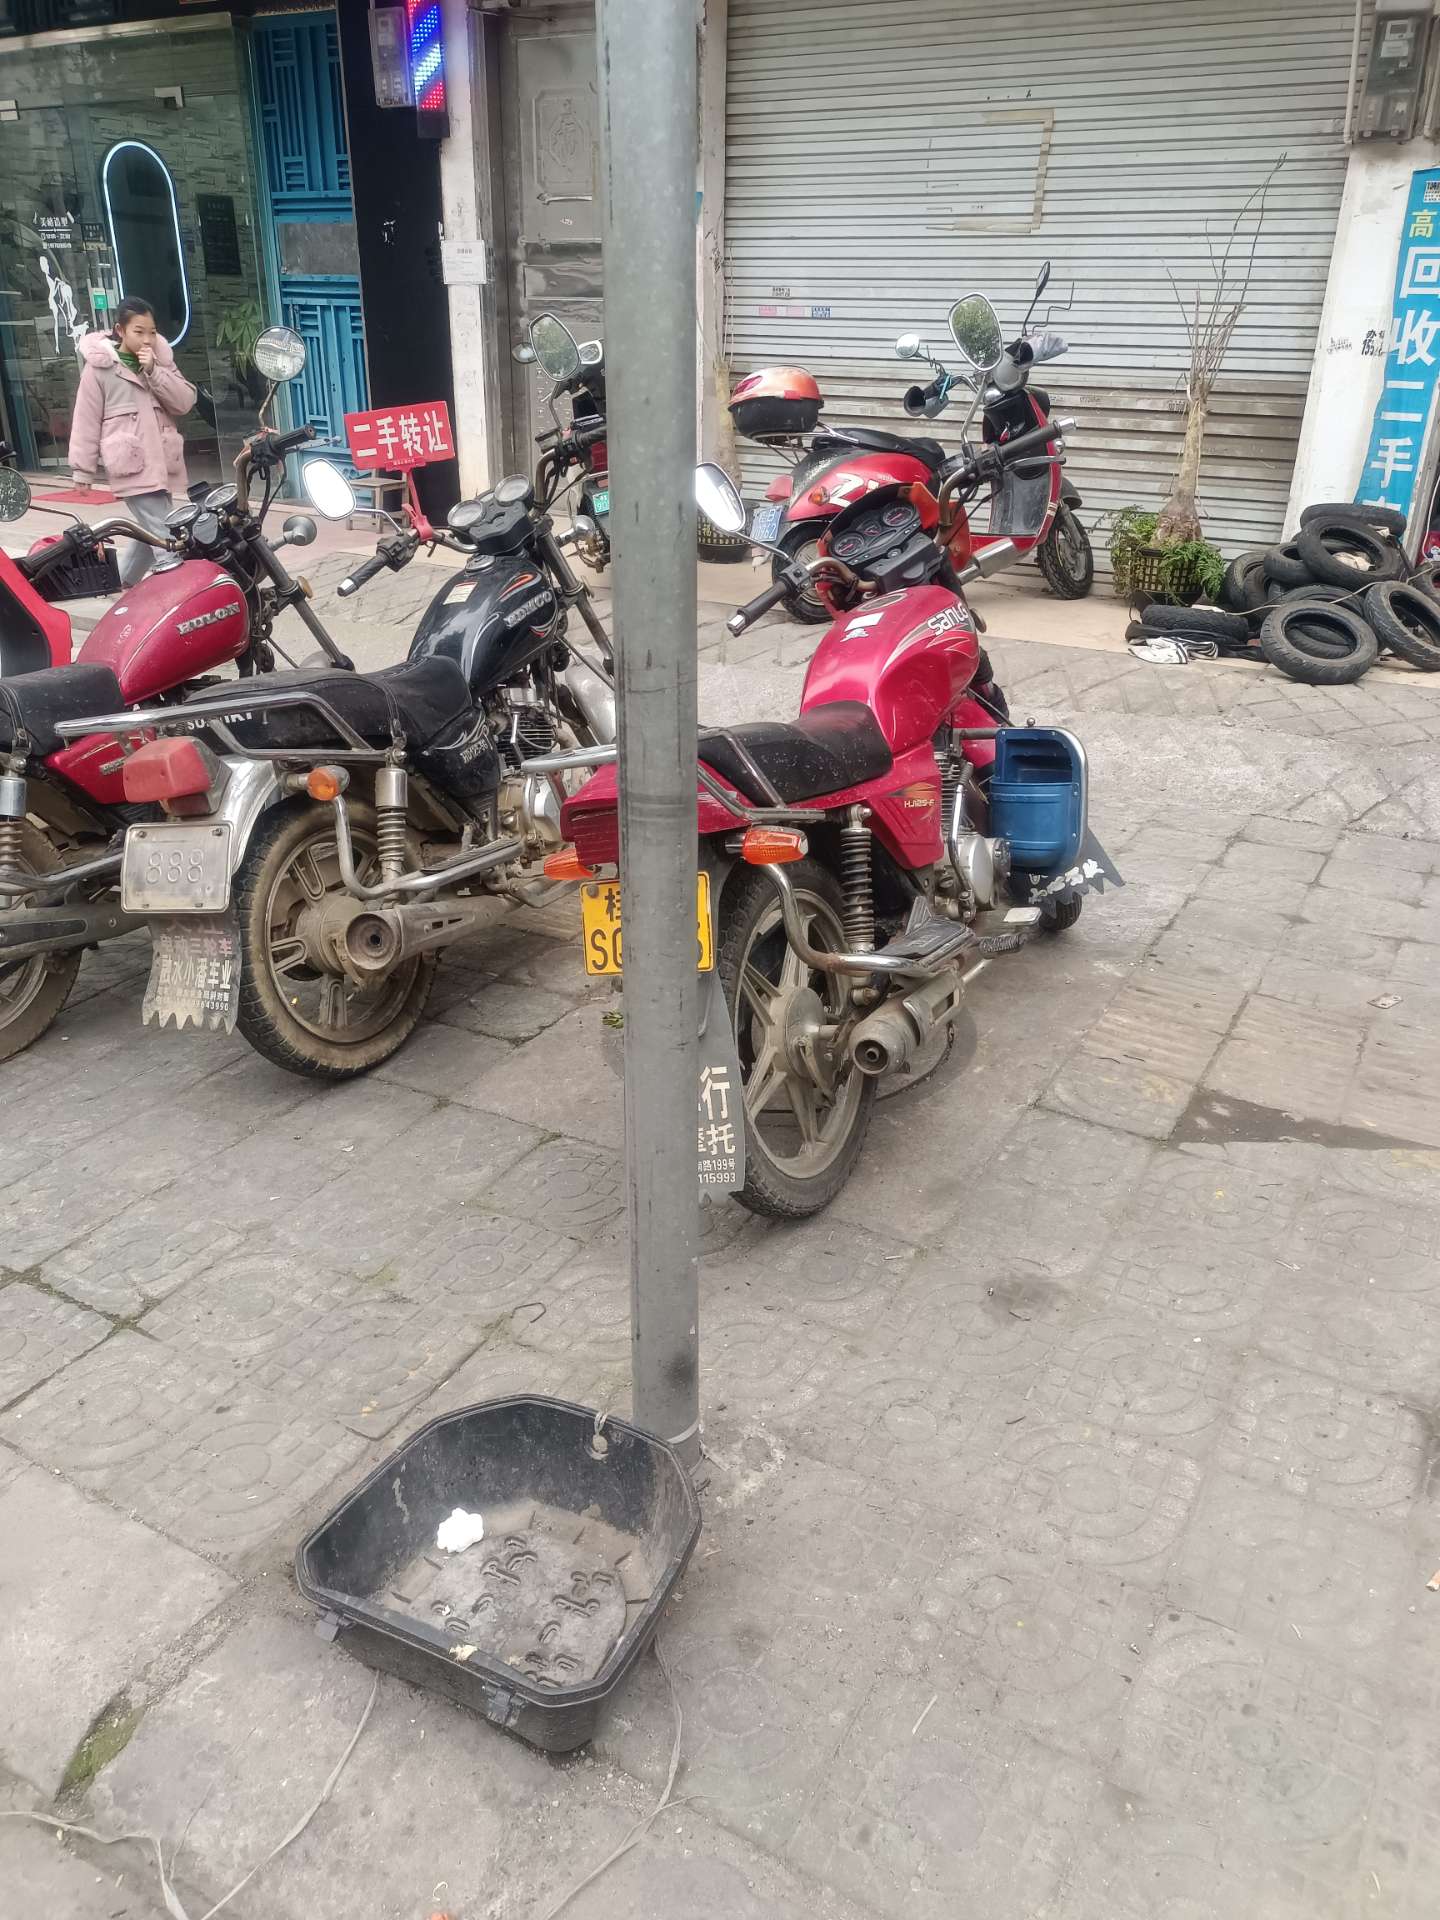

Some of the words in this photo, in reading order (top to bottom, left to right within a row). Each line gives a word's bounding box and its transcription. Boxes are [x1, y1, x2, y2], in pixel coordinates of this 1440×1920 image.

[1363, 246, 1440, 511] 回收二手
[353, 410, 449, 460] 二手转让
[146, 848, 204, 884] 888
[698, 1066, 730, 1121] 行
